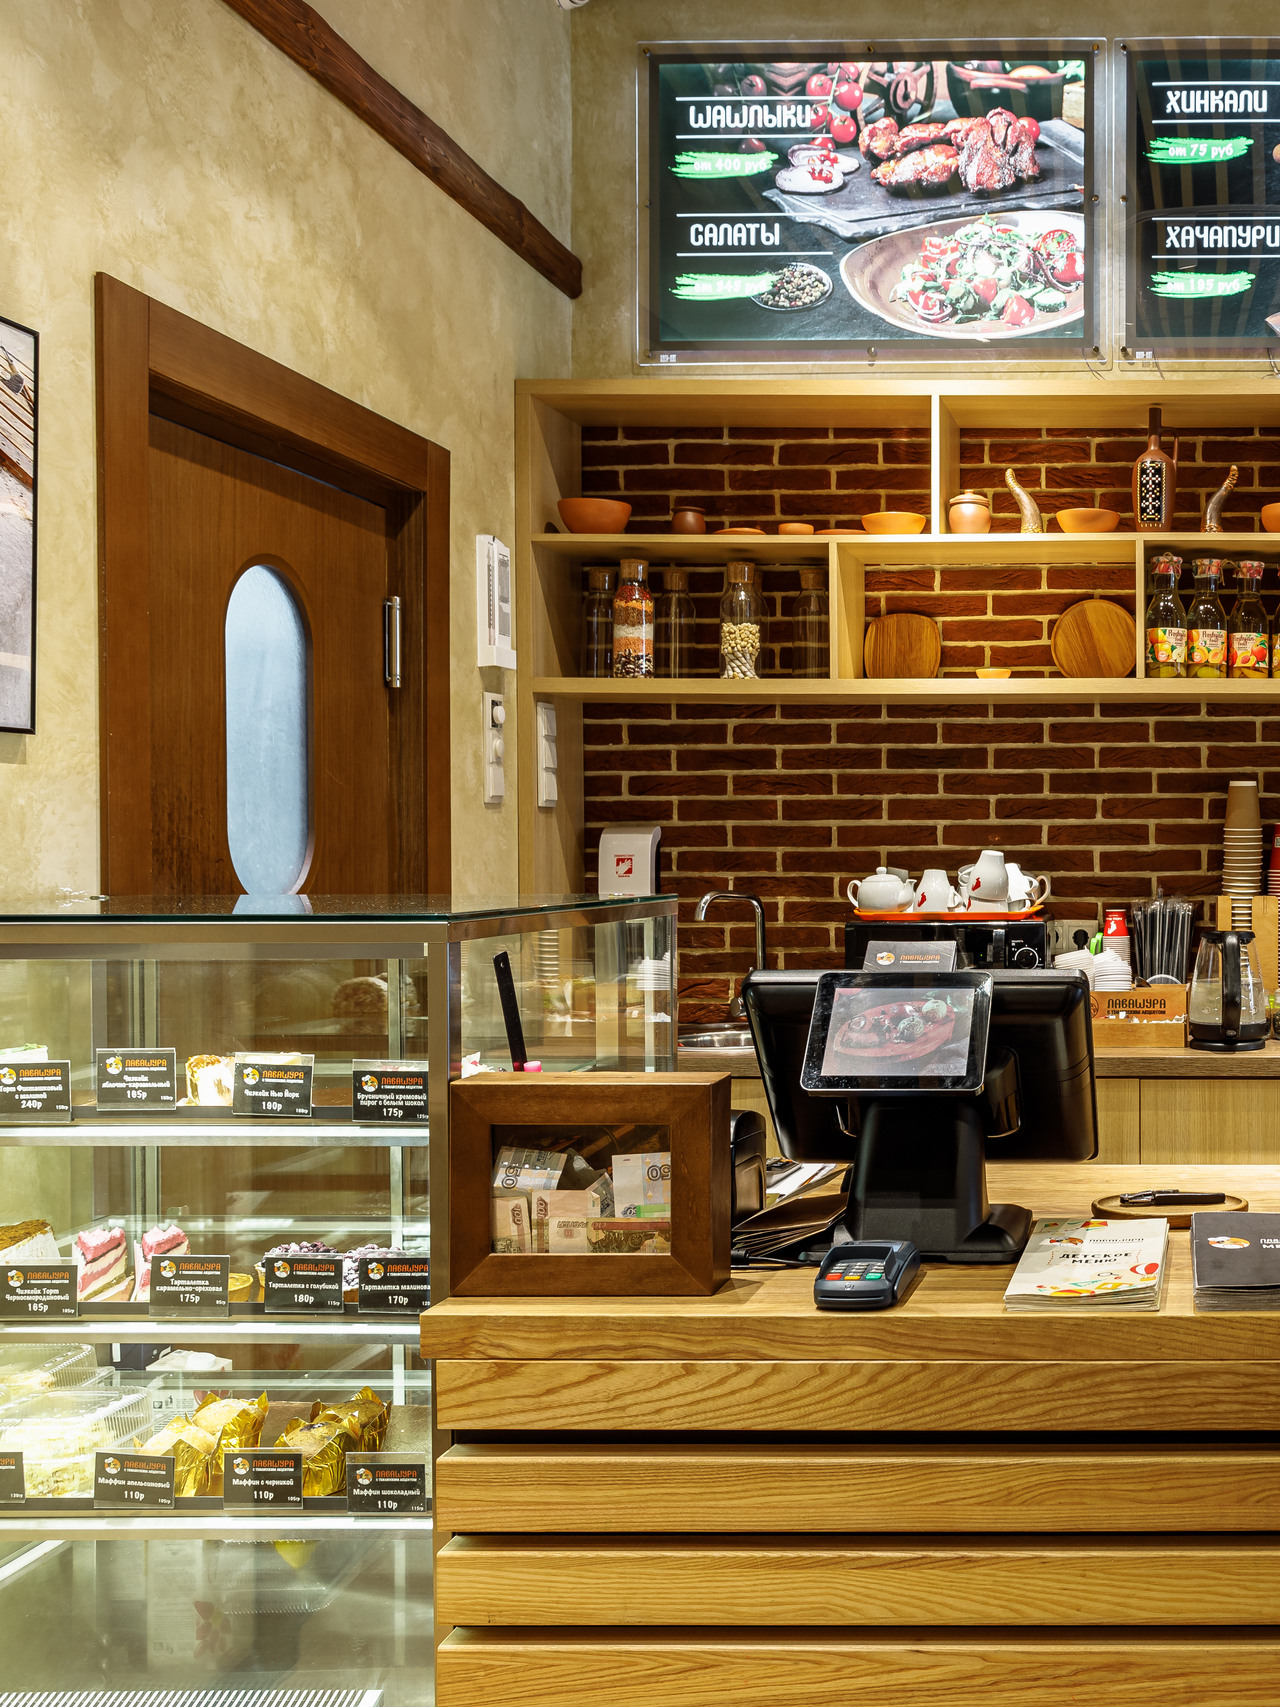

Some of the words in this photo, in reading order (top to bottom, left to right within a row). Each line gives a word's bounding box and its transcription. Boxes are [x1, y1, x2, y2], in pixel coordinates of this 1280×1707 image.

[1166, 90, 1267, 113] ХИНКАЛИ
[689, 105, 811, 128] ШАШЛЫКИ
[1169, 147, 1186, 156] от
[1190, 144, 1207, 156] 75
[1211, 143, 1233, 158] руб
[715, 158, 740, 171] 400
[745, 158, 767, 173] руб
[690, 223, 780, 246] САЛАТЫ
[1166, 225, 1280, 248] ХАЧАПУРИ
[1218, 278, 1240, 293] руб
[1107, 998, 1167, 1009] ЛАВАШУРА
[125, 1059, 167, 1067] ЛАВАШУРА
[19, 1068, 62, 1077] ЛАВАШУРА
[262, 1070, 304, 1079] ЛАВАШУРА
[381, 1077, 423, 1085] ЛАВАШУРА
[244, 1089, 269, 1098] Чизкейк
[270, 1090, 283, 1098] Нью
[284, 1088, 300, 1099] Йорк
[357, 1092, 394, 1101] Брусничный
[395, 1092, 427, 1101] кремовый
[21, 1100, 43, 1110] 240р
[360, 1099, 377, 1107] пирог
[382, 1107, 404, 1117] 175р
[179, 1263, 221, 1271] ЛАВАШУРА
[293, 1263, 335, 1272] ЛАВАШУРА
[387, 1264, 429, 1272] ЛАВАШУРА
[27, 1272, 70, 1280] ЛАВАШУРА
[170, 1278, 209, 1286] Тарталетка
[269, 1282, 304, 1290] Тарталетка
[310, 1283, 339, 1291] голубикой
[361, 1283, 400, 1291] Тарталетка
[42, 1288, 59, 1296] Торт
[5, 1293, 70, 1301] Черносмородиновый
[179, 1294, 200, 1304] 175р
[294, 1293, 314, 1304] 180р
[388, 1295, 408, 1305] 170р
[124, 1460, 166, 1470] ЛАВАШУРА
[252, 1459, 294, 1467] ЛАВАШУРА
[375, 1470, 417, 1478] ЛАВАШУРА
[98, 1477, 125, 1486] Маффин
[127, 1480, 170, 1488] апельсиновый
[232, 1479, 259, 1487] Маффин
[265, 1479, 294, 1487] черникой
[124, 1490, 145, 1501] 110р
[253, 1490, 274, 1500] 110р
[353, 1488, 380, 1497] Маффин
[381, 1488, 421, 1496] шоколадный
[377, 1500, 398, 1510] 110р
